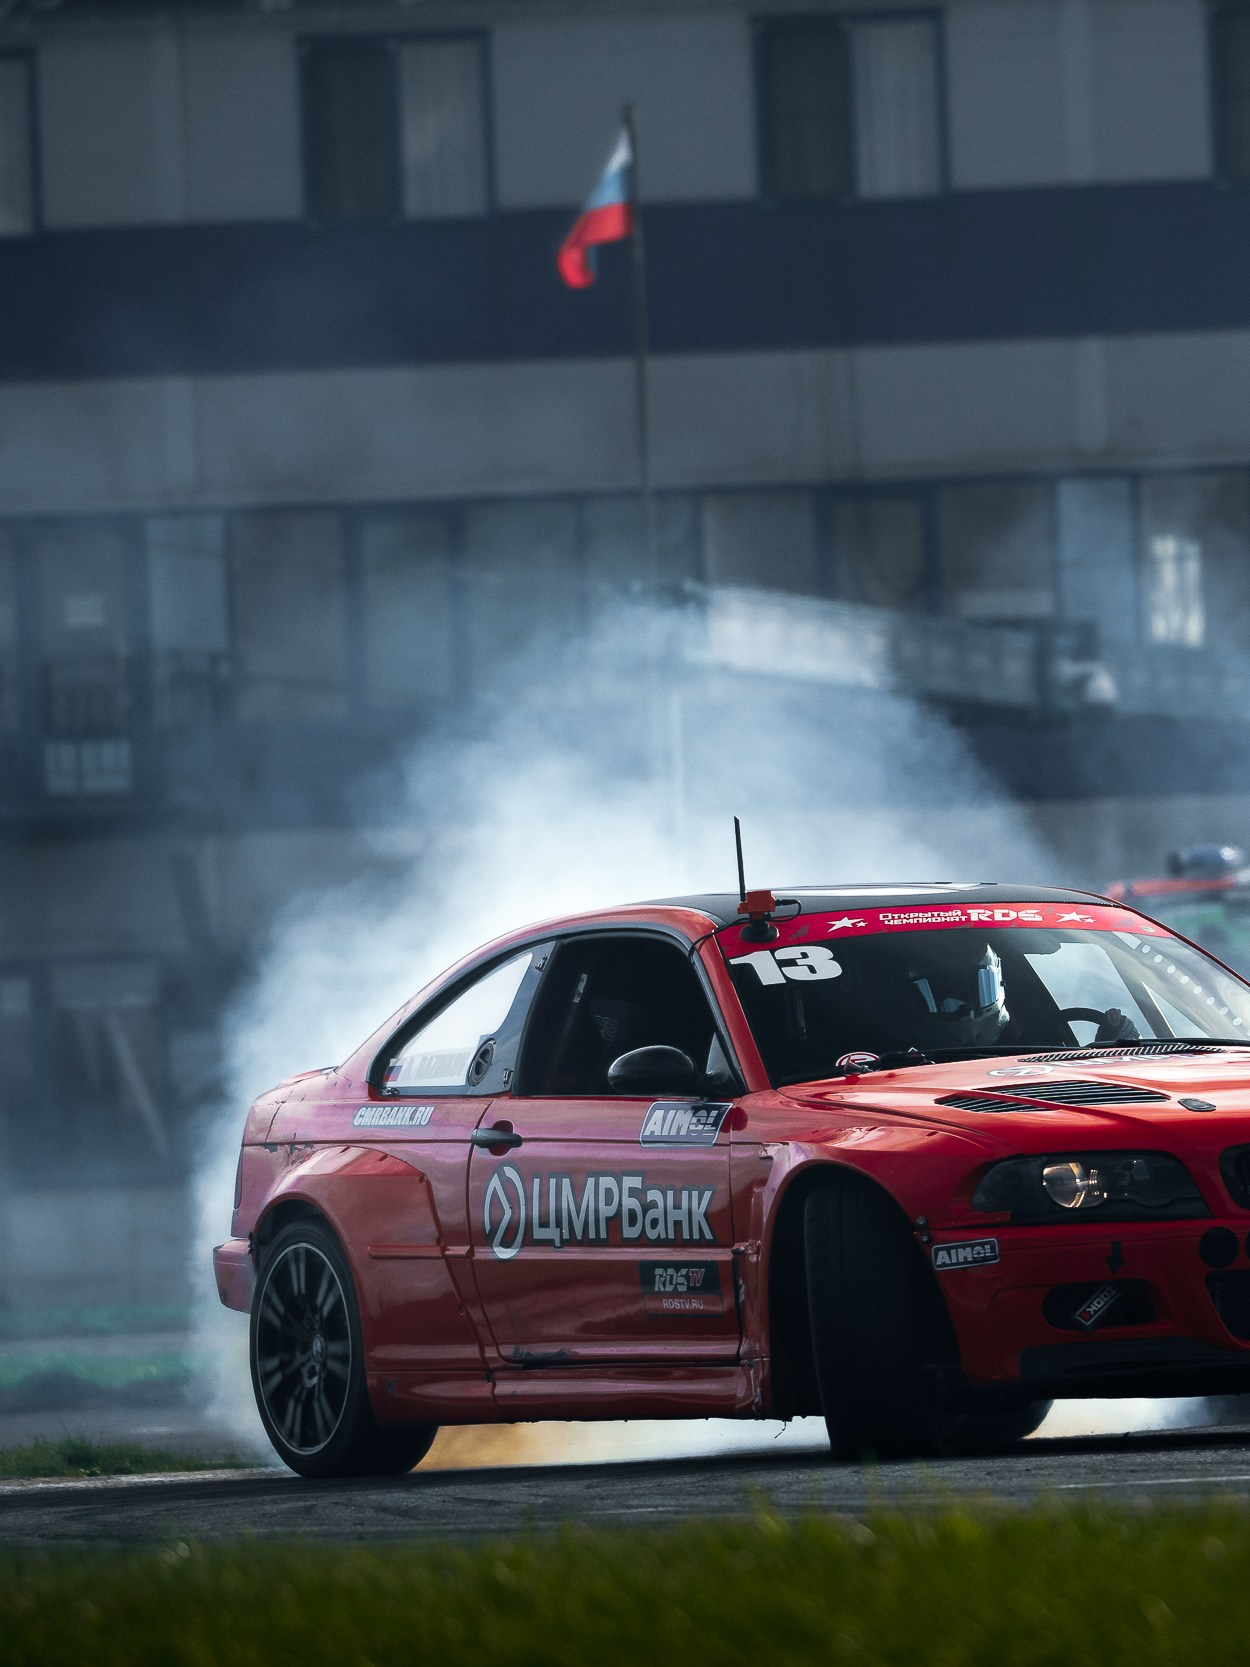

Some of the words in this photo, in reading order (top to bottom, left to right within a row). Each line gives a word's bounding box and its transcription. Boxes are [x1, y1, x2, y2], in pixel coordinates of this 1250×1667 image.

[967, 909, 1043, 922] RDS
[729, 945, 843, 986] 13
[353, 1106, 436, 1126] CMRBANK.RU
[645, 1109, 720, 1137] AIMOL
[532, 1175, 715, 1247] ЦМРБанк
[936, 1244, 996, 1265] AIMOL
[662, 1299, 704, 1310] RDSTV.RU
